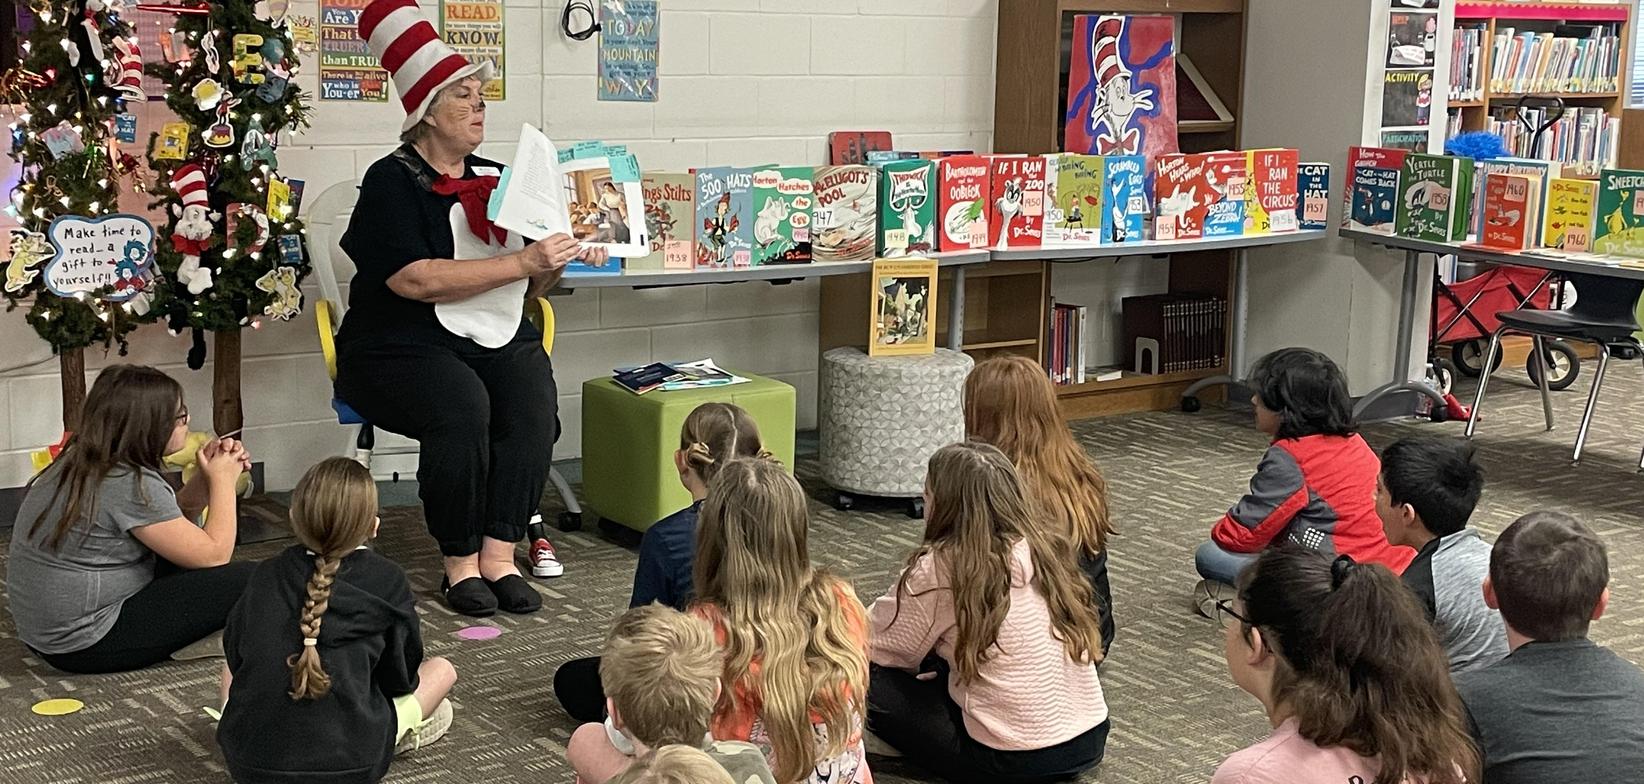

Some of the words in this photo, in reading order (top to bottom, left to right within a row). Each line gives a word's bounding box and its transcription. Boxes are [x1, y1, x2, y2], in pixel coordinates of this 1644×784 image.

[325, 11, 349, 24] Are
[447, 4, 501, 20] READ.
[323, 27, 352, 39] That
[608, 19, 654, 37] TODAY
[446, 31, 502, 45] KNOW.
[323, 55, 348, 65] than
[603, 47, 657, 62] MOUNTAIN
[364, 71, 387, 80] alive
[1385, 72, 1420, 83] ACTIVITY
[1264, 154, 1274, 167] IF
[1275, 154, 1280, 167] I
[998, 161, 1009, 175] IF
[1012, 160, 1018, 176] I
[1022, 161, 1043, 175] RAN
[1268, 167, 1288, 181] RAN
[1304, 166, 1328, 176] CAT
[1362, 169, 1374, 177] CAT
[1382, 171, 1396, 179] HAT
[699, 172, 713, 183] The
[1355, 176, 1377, 186] COMES
[1378, 178, 1396, 188] BACK
[702, 178, 722, 200] 500
[727, 173, 752, 190] HATS
[779, 182, 810, 192] Hatches
[1025, 179, 1044, 191] ZOO
[1263, 181, 1281, 195] THE
[663, 183, 692, 201] Stilts
[818, 188, 847, 207] POOL
[1304, 189, 1328, 199] HAT
[796, 198, 808, 207] the
[1262, 194, 1295, 209] CIRCUS
[792, 215, 807, 225] Egg
[64, 227, 96, 240] Make
[102, 225, 125, 238] time
[130, 225, 142, 237] to
[1567, 234, 1586, 246] 1960
[107, 243, 115, 252] a
[666, 253, 688, 264] 1938
[62, 258, 86, 273] gift
[93, 258, 103, 267] to
[53, 273, 111, 289] yourself!!
